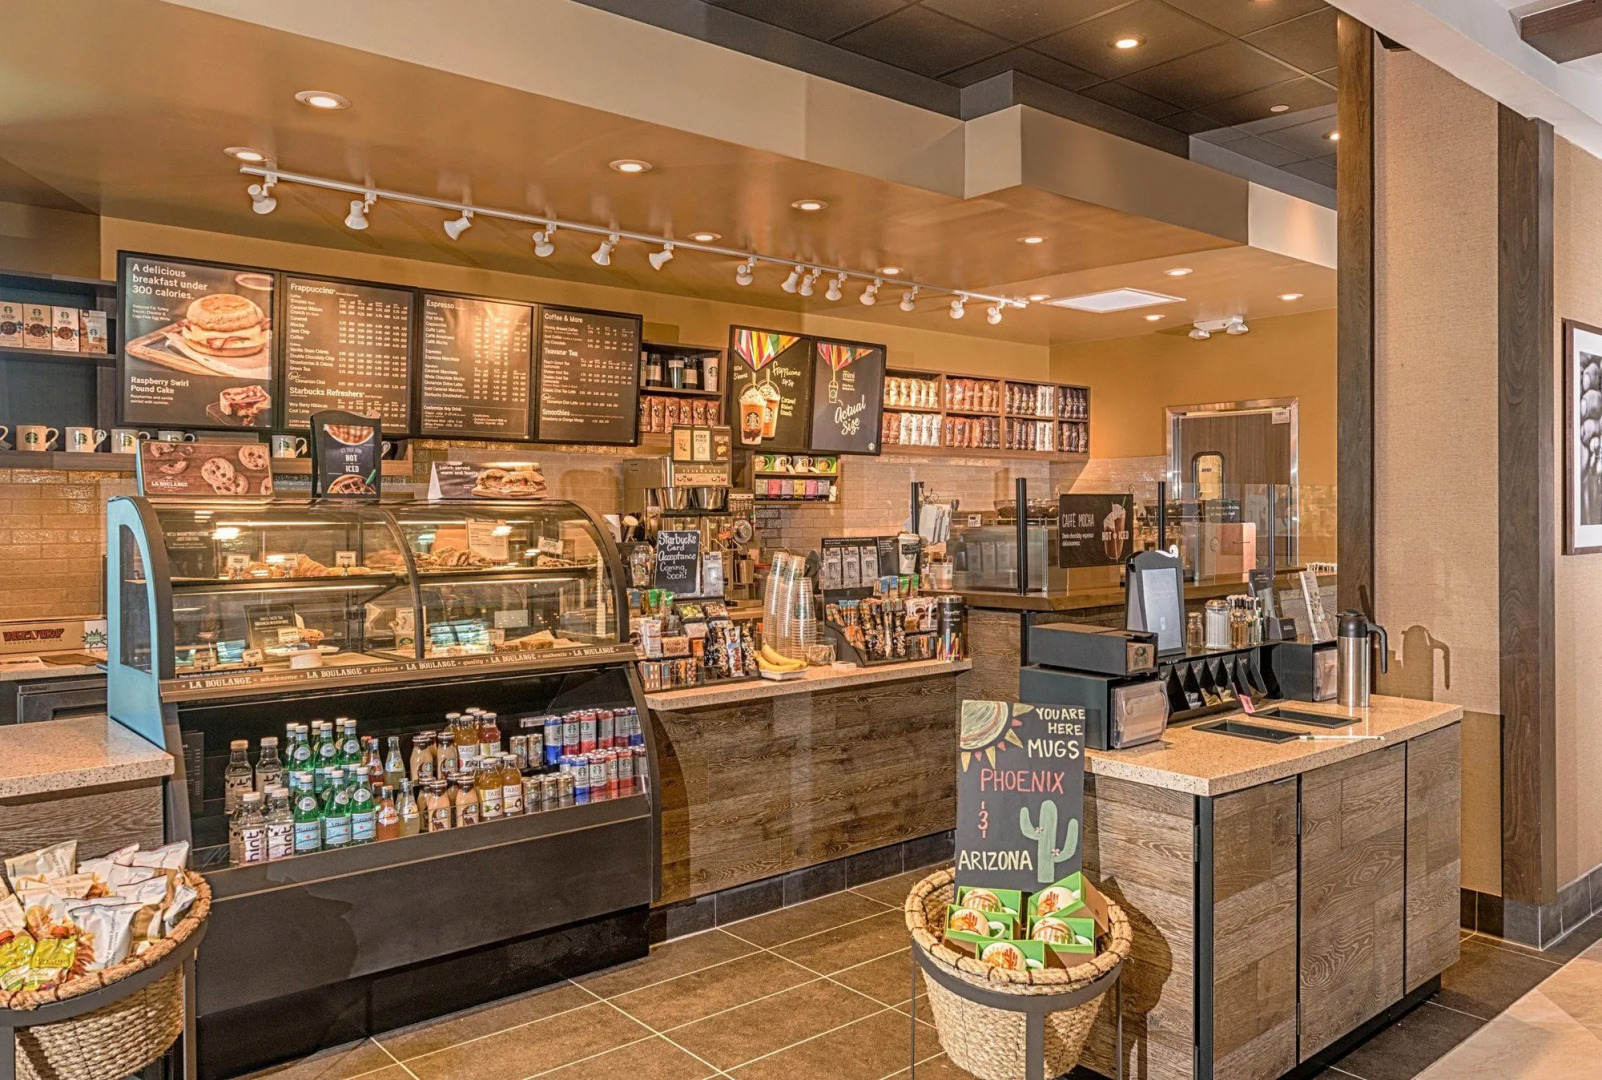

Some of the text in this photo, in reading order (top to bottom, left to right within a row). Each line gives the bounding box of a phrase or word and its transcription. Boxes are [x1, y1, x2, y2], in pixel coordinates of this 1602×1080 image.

[132, 263, 187, 278] A delicious
[132, 274, 209, 291] breakfast under
[132, 285, 195, 300] 300 calories.
[426, 300, 455, 309] Espresso
[544, 313, 563, 321] Coffee
[568, 349, 578, 357] Tea
[131, 376, 189, 387] Raspberry Swirl
[130, 384, 175, 394] Pound Cake
[289, 386, 325, 396] Starbucks
[542, 408, 570, 416] Smoothies
[835, 394, 866, 424] Actual
[841, 417, 860, 435] Size
[345, 454, 358, 462] HOT
[1078, 513, 1095, 528] MOCHA
[658, 532, 697, 545] Starbucks
[1101, 530, 1130, 541] HOT ICED
[666, 543, 685, 551] Card
[658, 550, 697, 564] Acceptance
[660, 561, 685, 574] Coming
[666, 569, 687, 580] Soon!
[188, 681, 202, 689] LA
[205, 677, 252, 687] BOULANGE
[260, 674, 298, 683] wholesome
[306, 671, 318, 679] LA
[321, 668, 363, 678] BOULANGE
[370, 666, 399, 674] delicious
[405, 663, 417, 671] LA
[419, 660, 456, 670] BOULANGE
[463, 658, 484, 666] quality
[490, 655, 500, 664] LA
[502, 653, 537, 662] BOULANGE
[584, 646, 615, 656] BOULANGE
[1035, 707, 1086, 720] YOU ARE
[1048, 722, 1084, 736] HERE
[1027, 738, 1080, 760] MUGS
[980, 767, 1065, 795] PHOENIX
[247, 830, 260, 863] hint
[281, 825, 292, 857] hint
[957, 849, 1034, 871] ARIZONA
